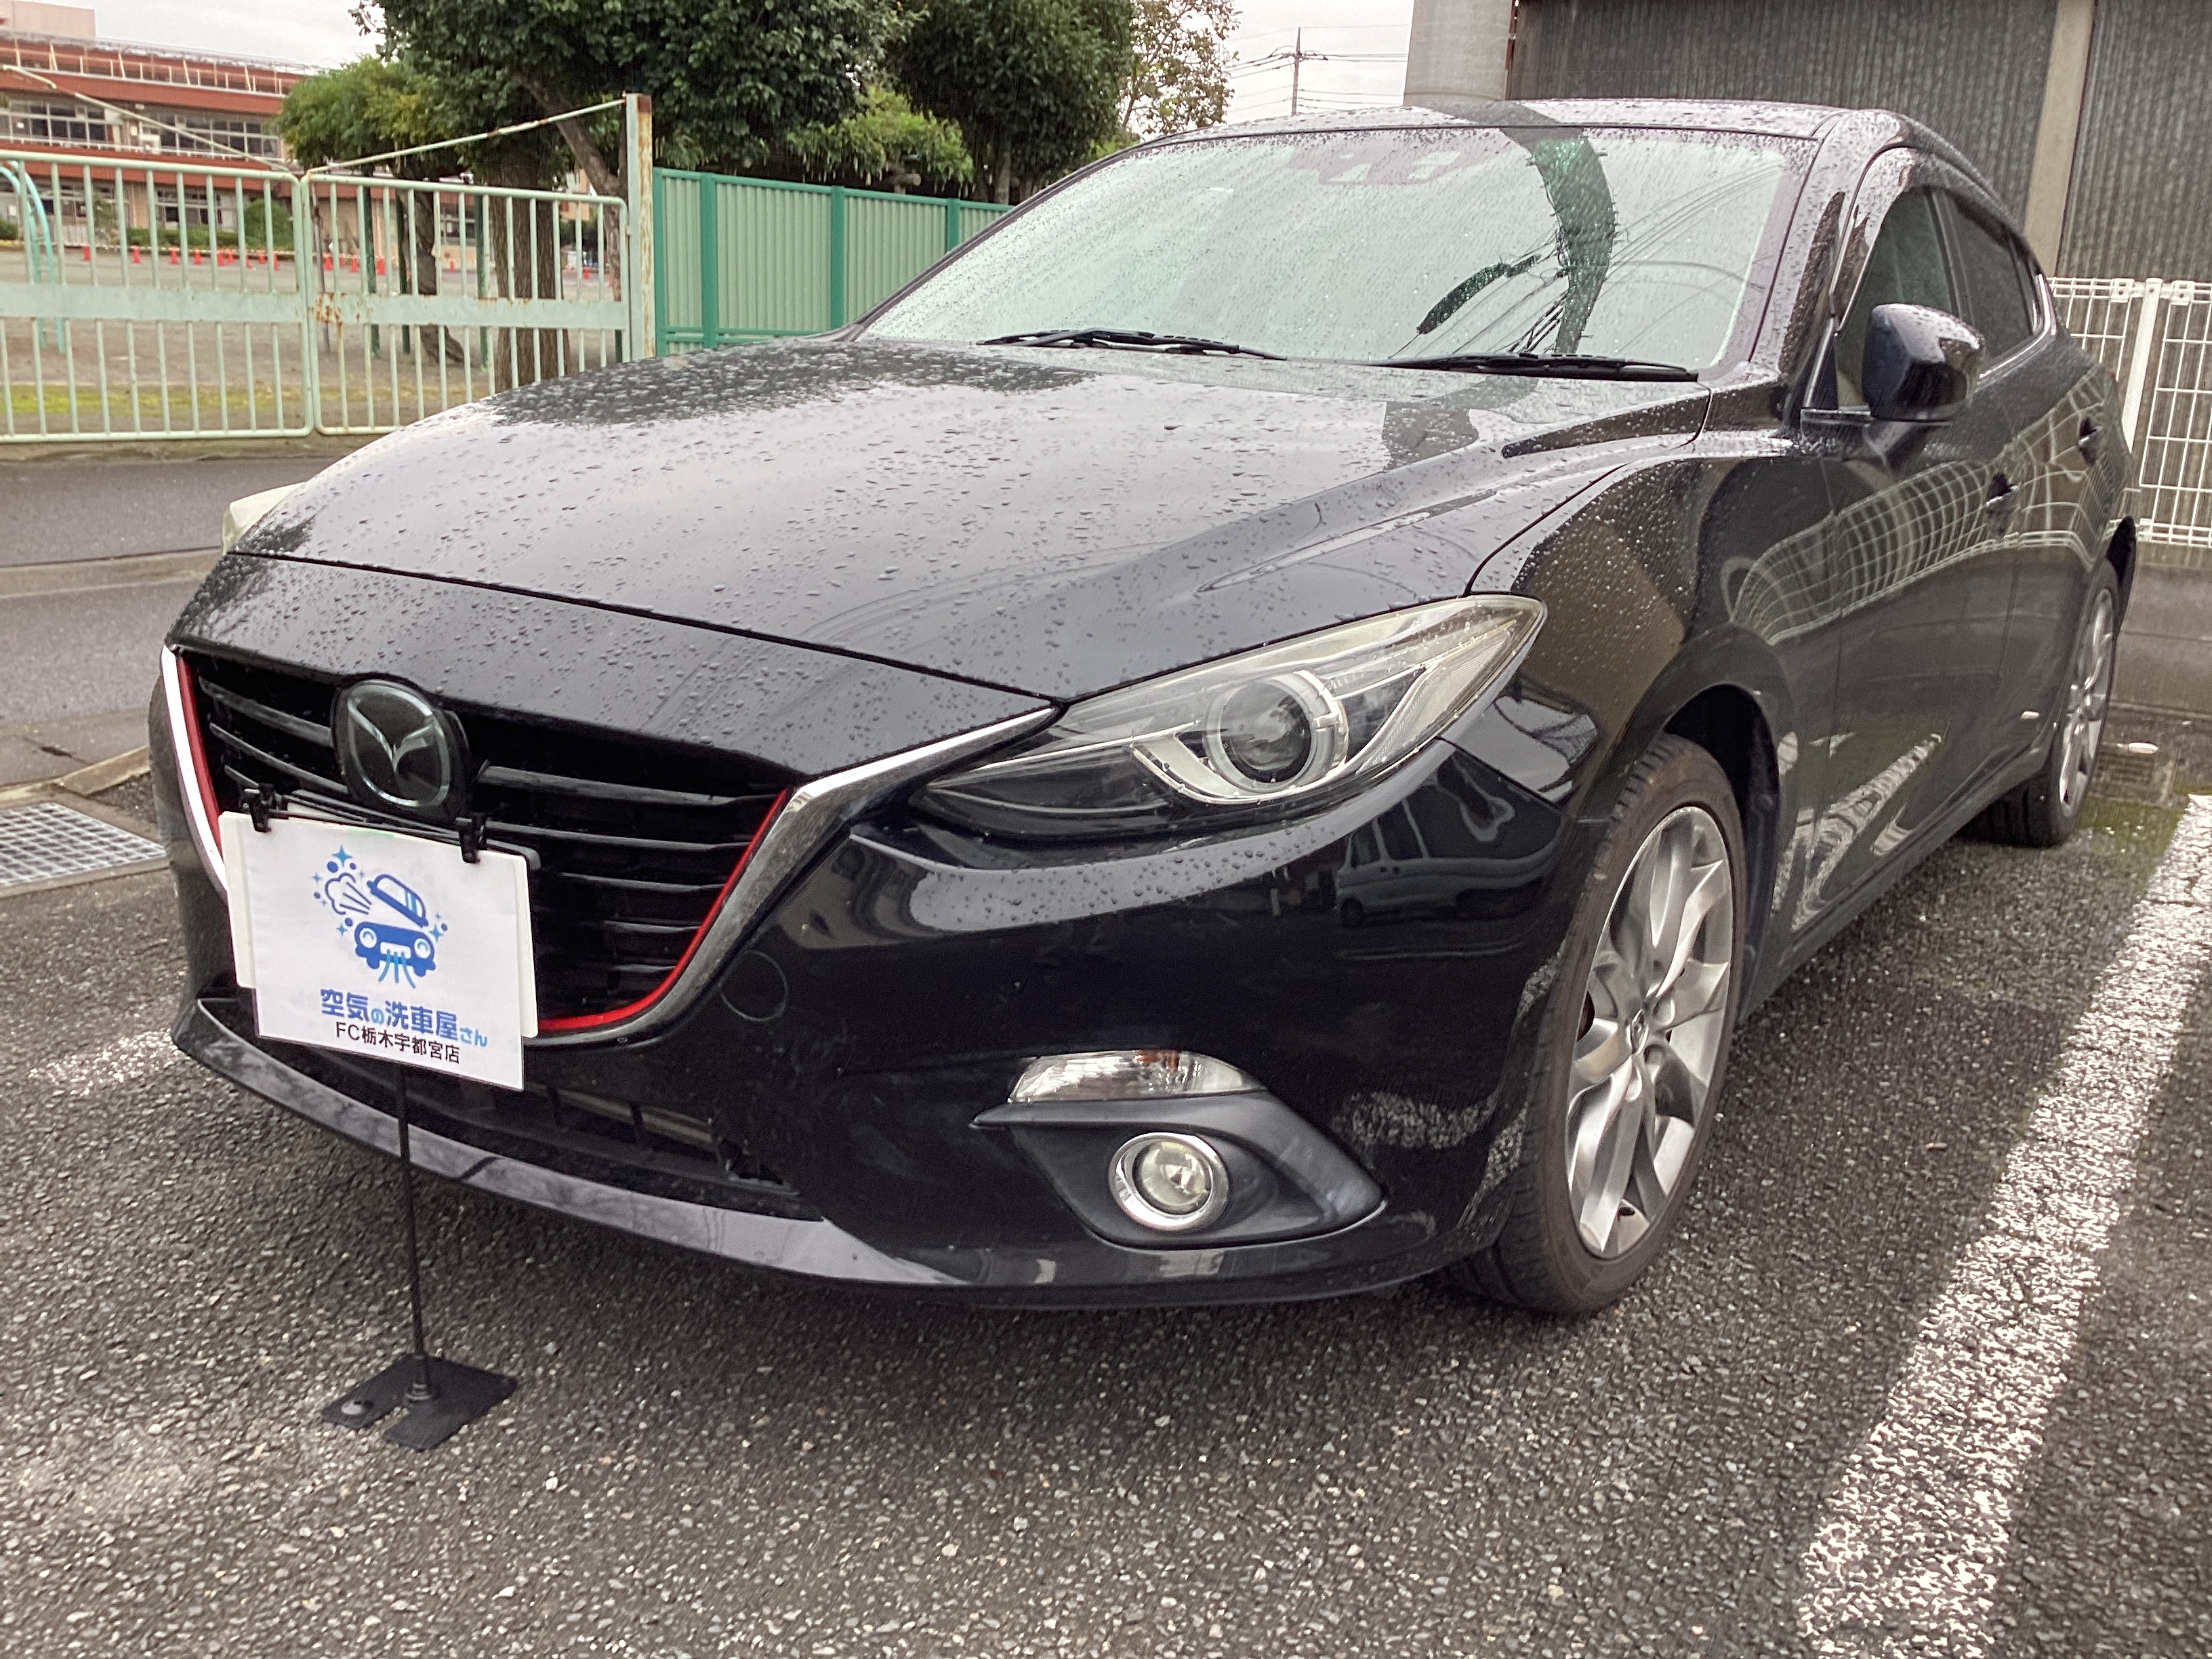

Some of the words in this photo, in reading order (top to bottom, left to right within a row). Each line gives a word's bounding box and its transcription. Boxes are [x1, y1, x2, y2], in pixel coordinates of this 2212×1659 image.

[321, 989, 487, 1047] 空気の洗車屋さん
[336, 1021, 460, 1064] FC栃木宇都宮店
